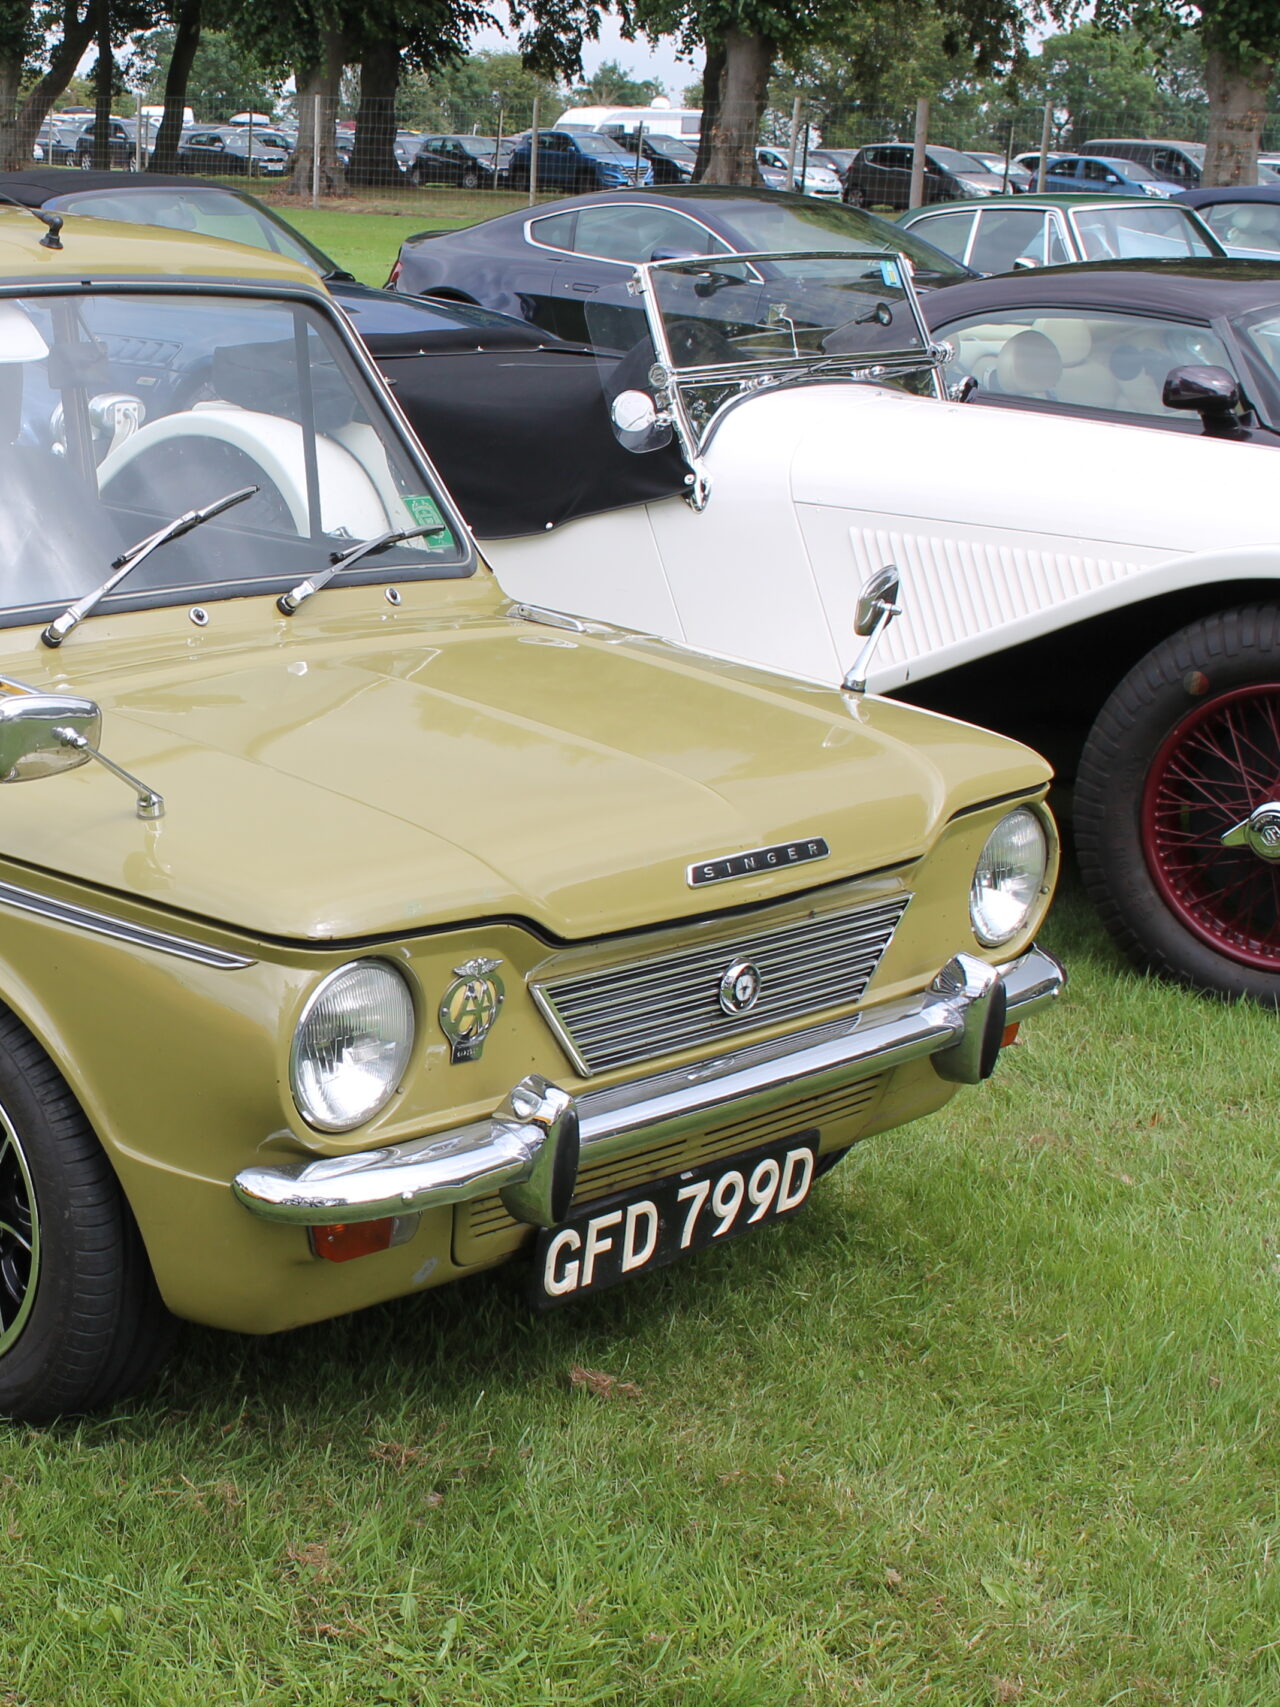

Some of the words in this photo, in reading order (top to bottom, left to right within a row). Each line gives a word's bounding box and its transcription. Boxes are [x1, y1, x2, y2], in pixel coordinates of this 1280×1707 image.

[704, 843, 820, 878] SINGER
[452, 979, 496, 1037] AA
[544, 1200, 659, 1296] GFD
[677, 1147, 814, 1249] 799D
